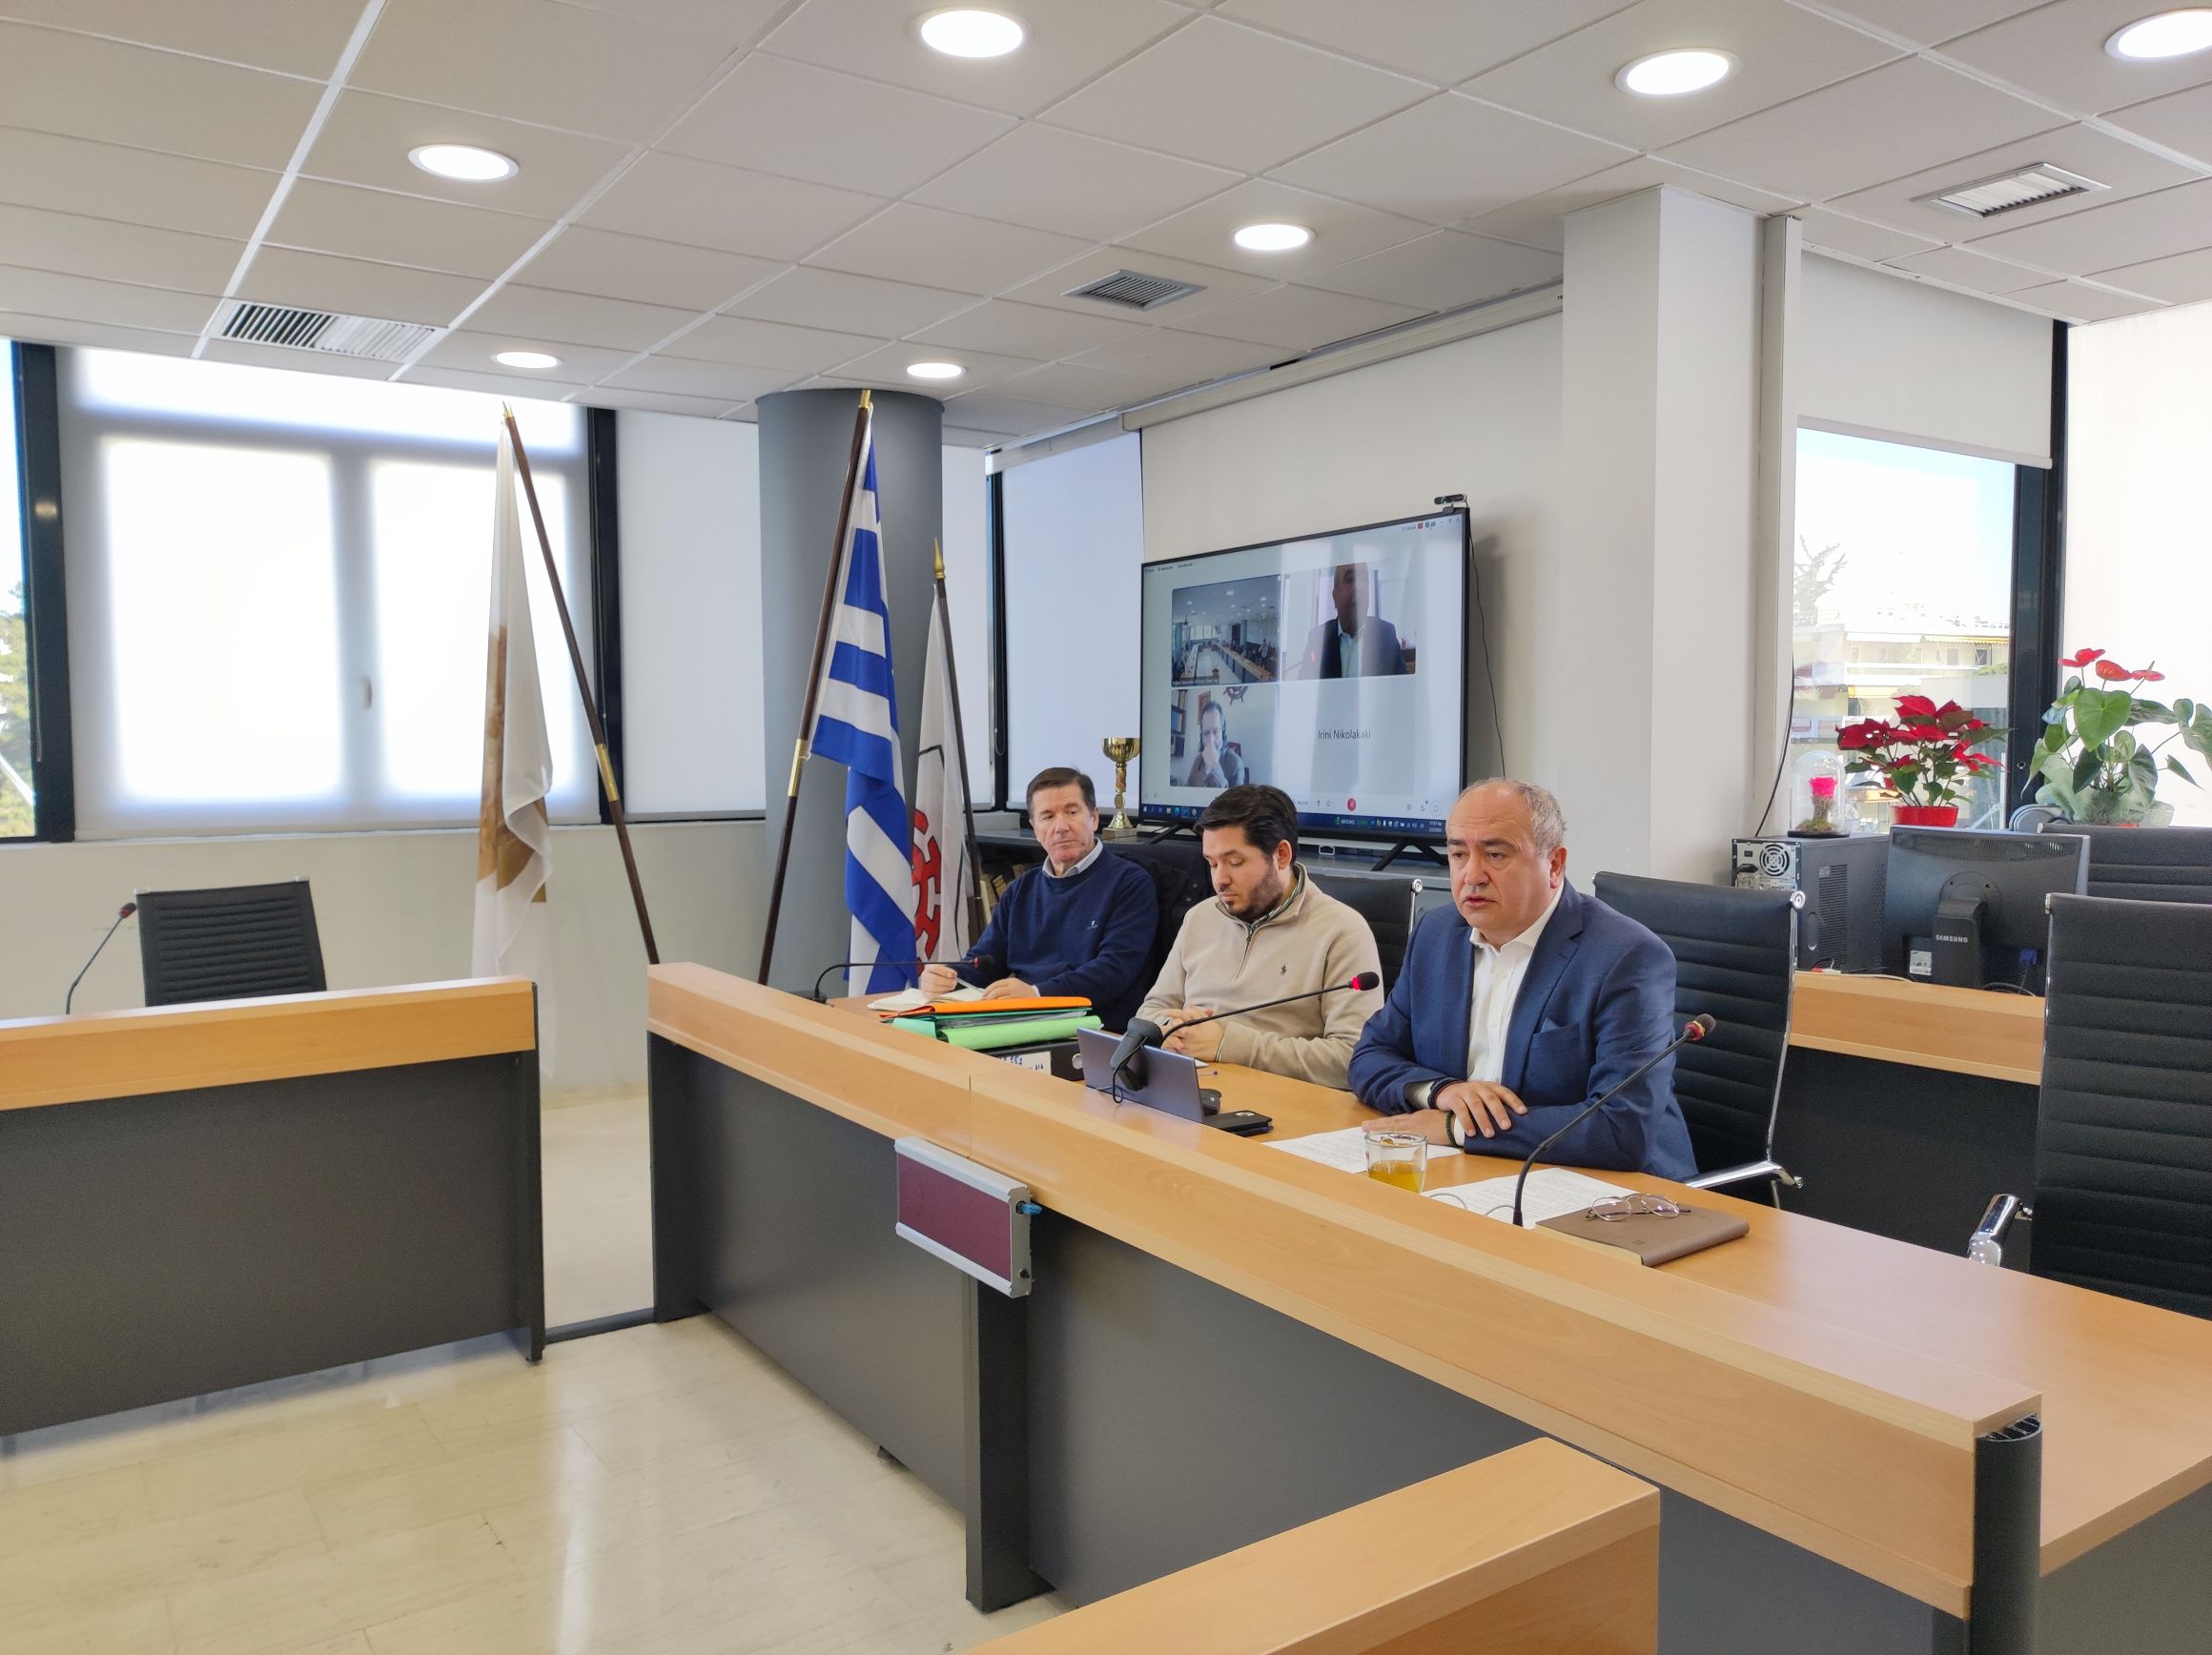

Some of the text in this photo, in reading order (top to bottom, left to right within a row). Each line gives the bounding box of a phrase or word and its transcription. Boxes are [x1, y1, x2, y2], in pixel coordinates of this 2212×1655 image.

[1318, 729, 1371, 740] Irini Nikolakaki
[1936, 934, 1968, 943] SAMSUNG
